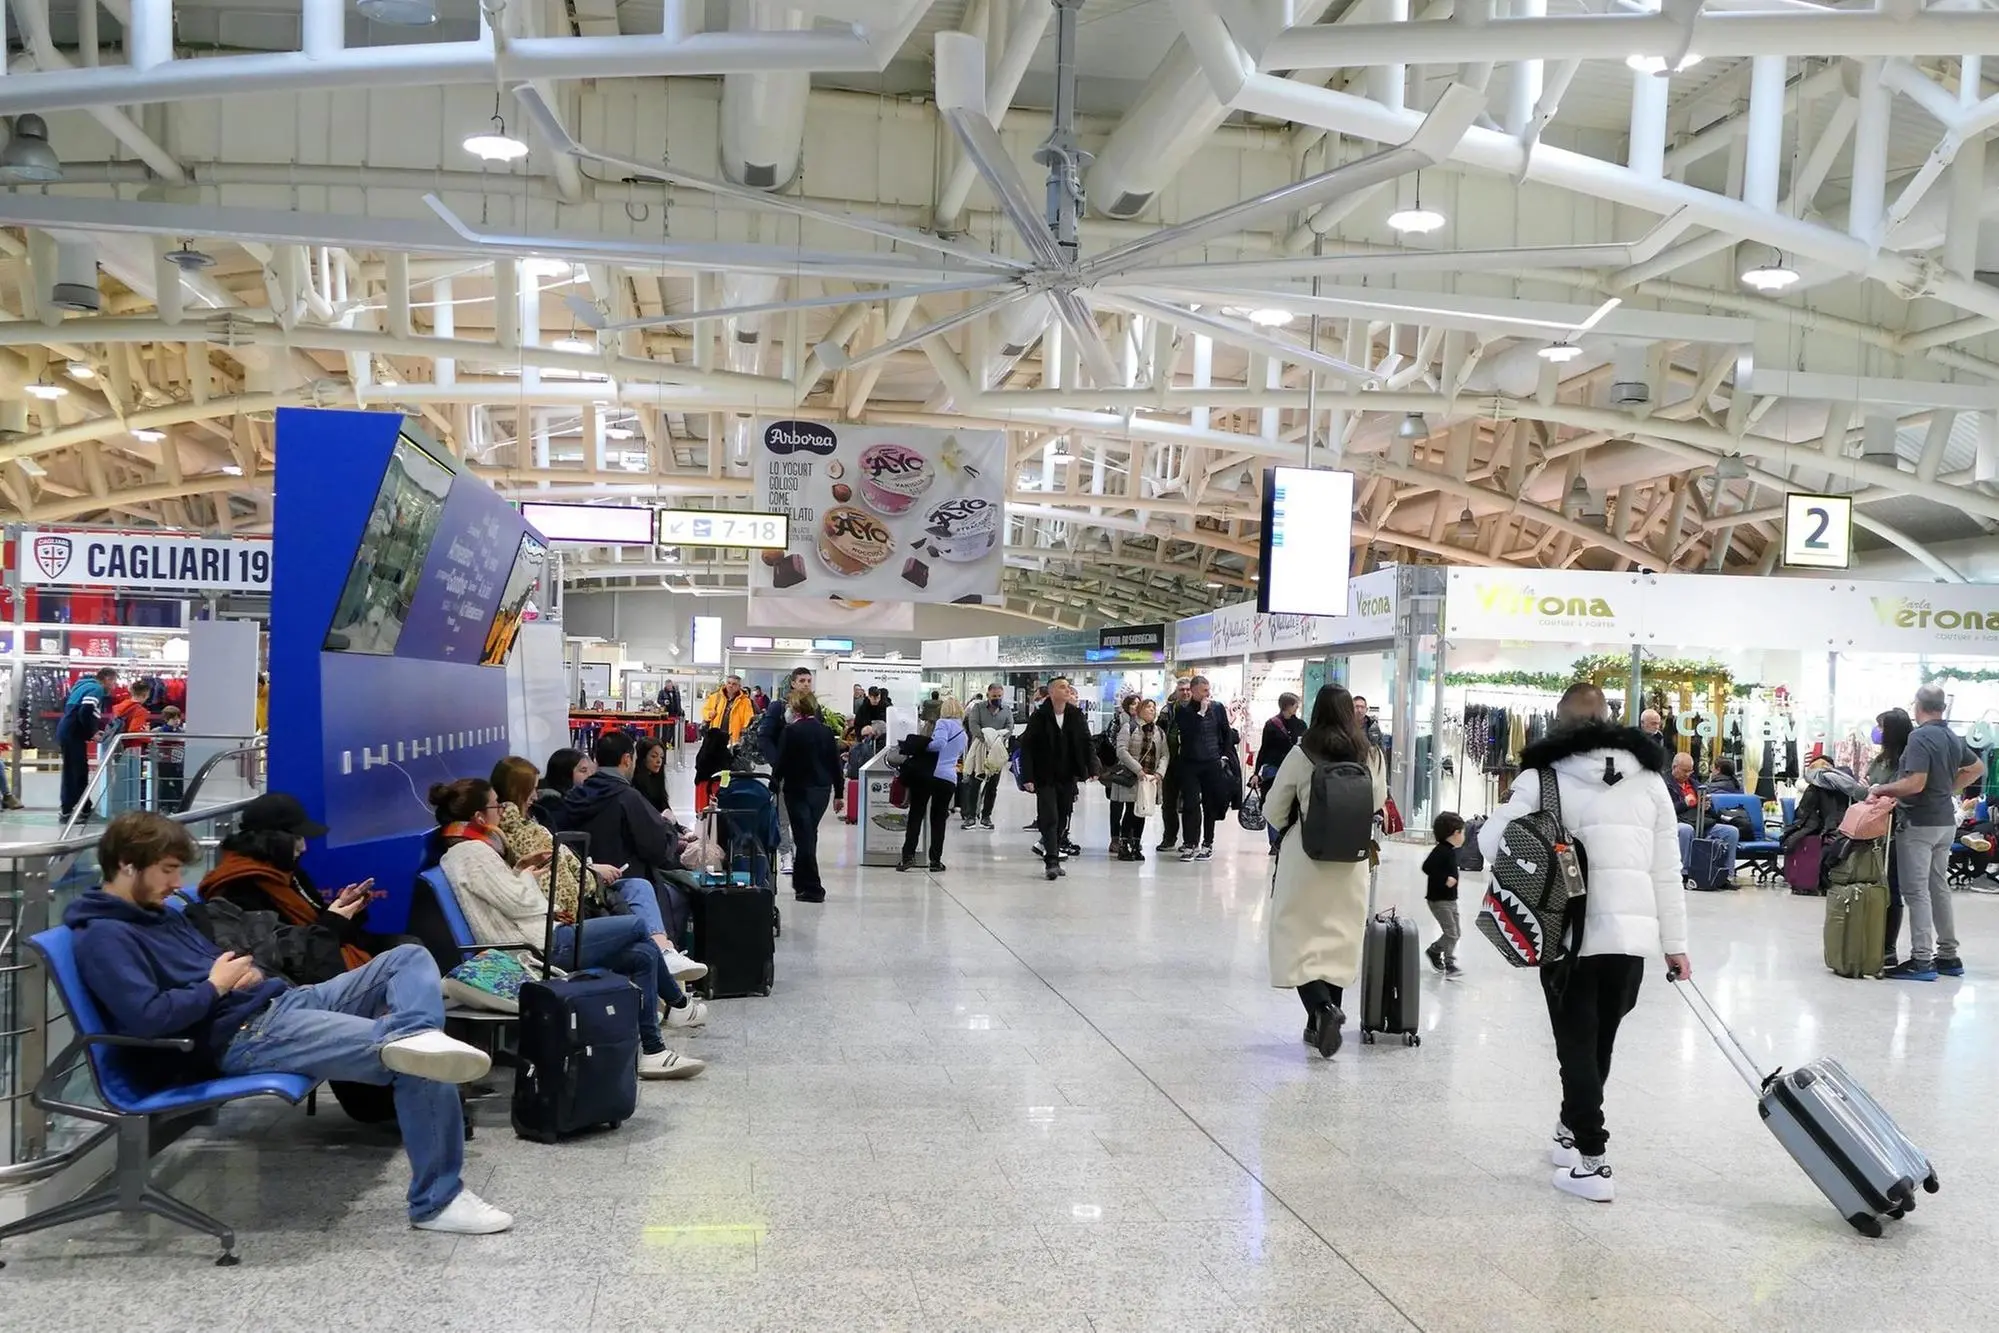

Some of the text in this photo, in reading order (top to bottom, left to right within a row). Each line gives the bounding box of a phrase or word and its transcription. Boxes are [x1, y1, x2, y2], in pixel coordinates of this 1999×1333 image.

[769, 428, 834, 447] Arborea
[769, 461, 814, 477] LO YOGURT
[769, 476, 799, 491] GOLOSO
[768, 491, 790, 506] COME
[722, 519, 777, 541] 7-18
[1804, 507, 1830, 550] 2
[87, 542, 270, 584] CAGLIARI 19
[1356, 590, 1391, 617] Verona
